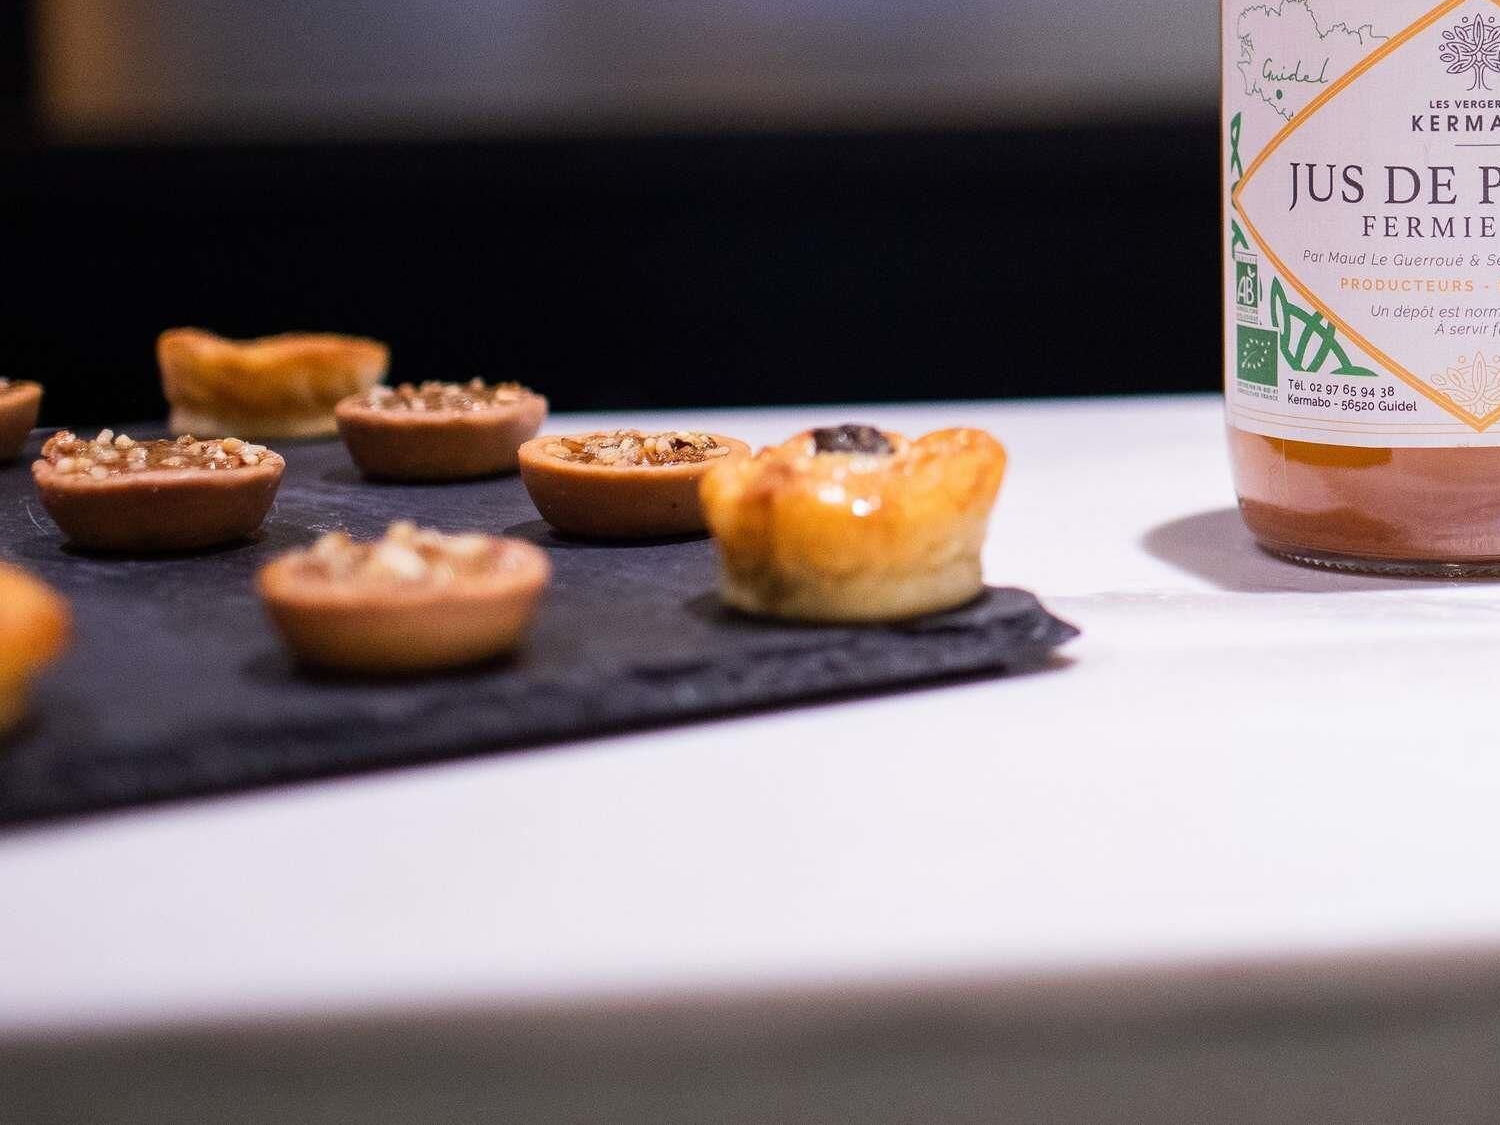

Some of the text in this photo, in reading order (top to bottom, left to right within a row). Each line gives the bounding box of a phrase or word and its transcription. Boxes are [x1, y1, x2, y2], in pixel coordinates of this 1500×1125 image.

[1262, 58, 1329, 83] Guidel
[1429, 100, 1450, 109] LES
[1289, 162, 1364, 211] JUS
[1384, 165, 1457, 204] DE
[1303, 250, 1322, 262] Par
[1328, 252, 1366, 265] Maud
[1371, 254, 1388, 265] Le
[1394, 253, 1464, 266] Guerroué
[1470, 254, 1480, 266] &
[1340, 277, 1474, 292] PRODUCTEURS
[1370, 305, 1389, 317] Un
[1393, 305, 1434, 320] dépôt
[1439, 306, 1460, 318] est
[1449, 322, 1489, 335] servir
[1288, 379, 1306, 391] Tél.
[1310, 383, 1322, 392] 02
[1325, 384, 1339, 395] 97
[1343, 384, 1356, 396] 65
[1360, 387, 1375, 397] 94
[1380, 387, 1395, 397] 38
[1288, 395, 1331, 408] Kermabo
[1341, 401, 1375, 412] 56520
[1378, 400, 1417, 412] Guidel
